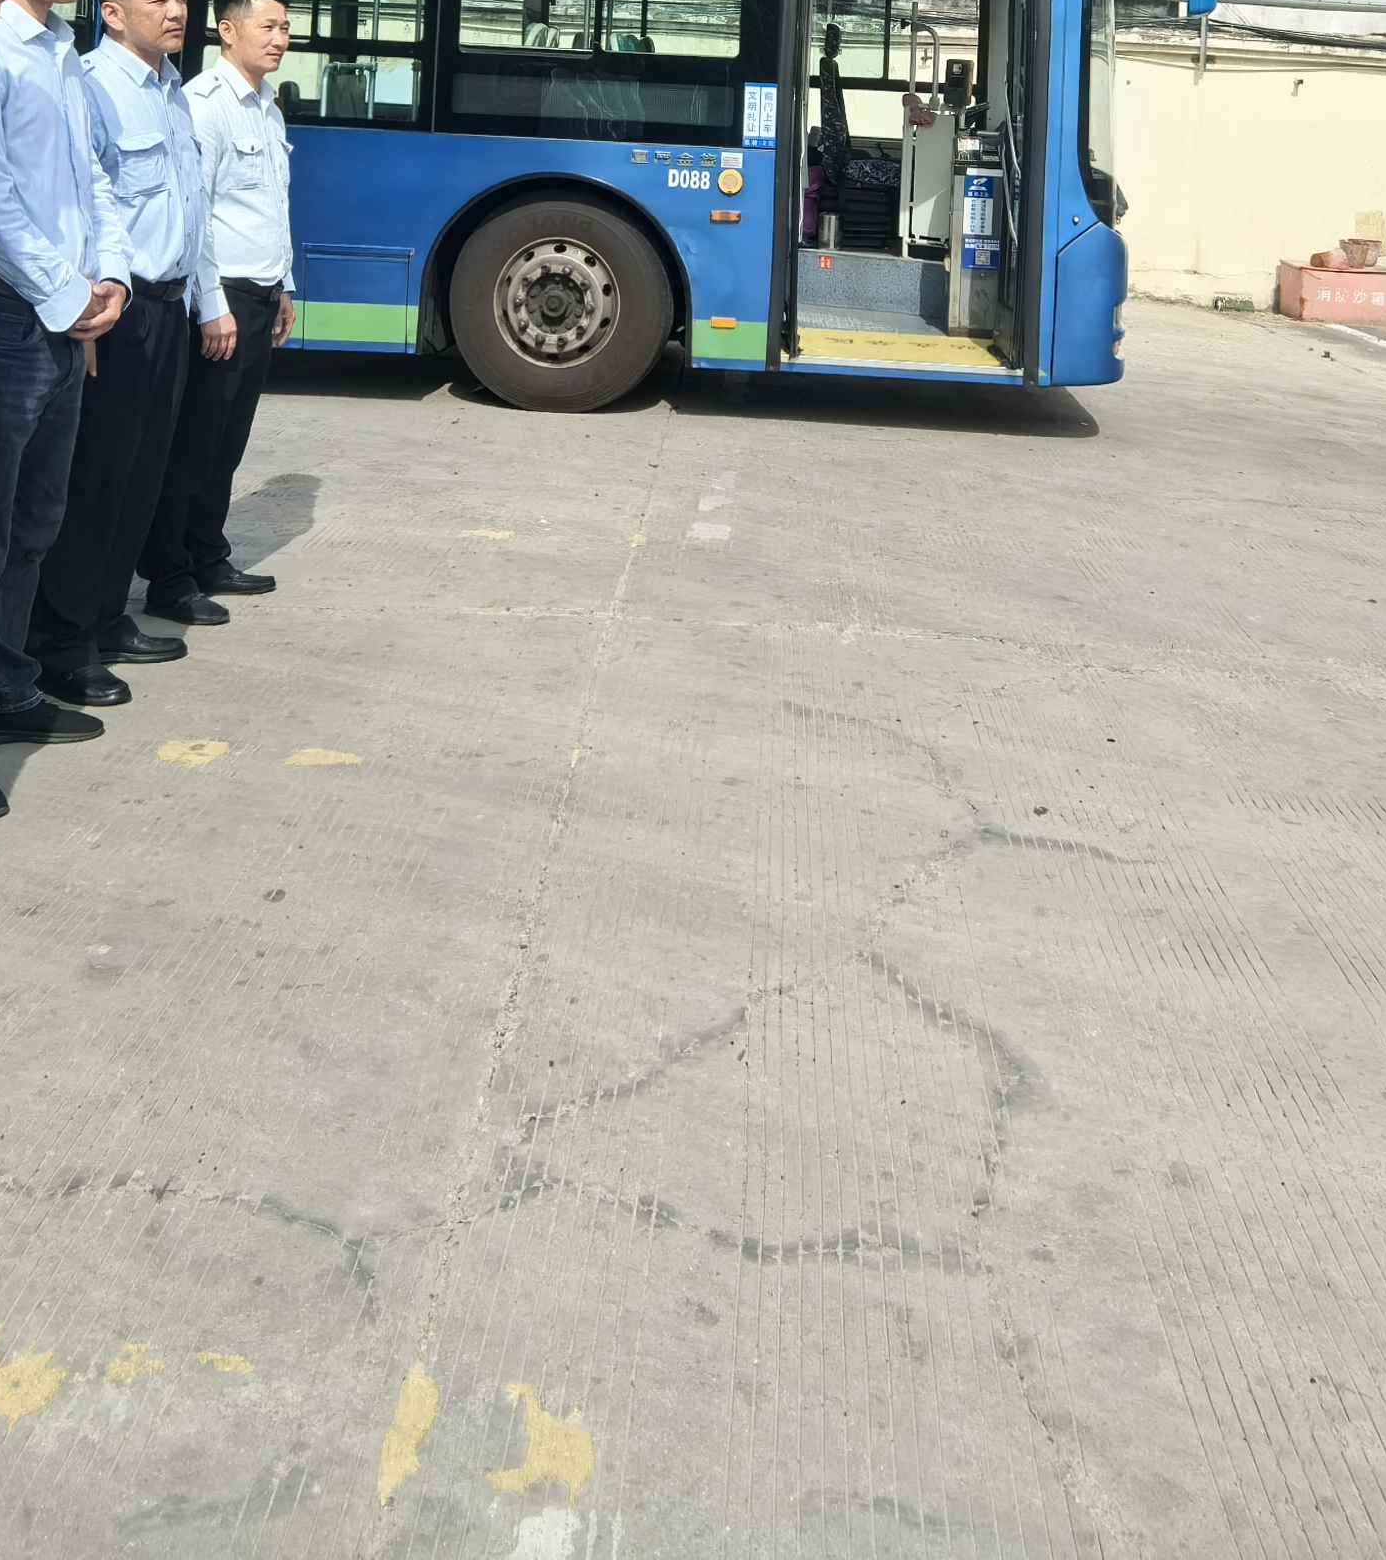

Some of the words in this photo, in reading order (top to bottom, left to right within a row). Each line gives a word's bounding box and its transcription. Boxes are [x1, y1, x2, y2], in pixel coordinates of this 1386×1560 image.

[763, 91, 775, 134] 前门上车
[667, 168, 711, 190] D088
